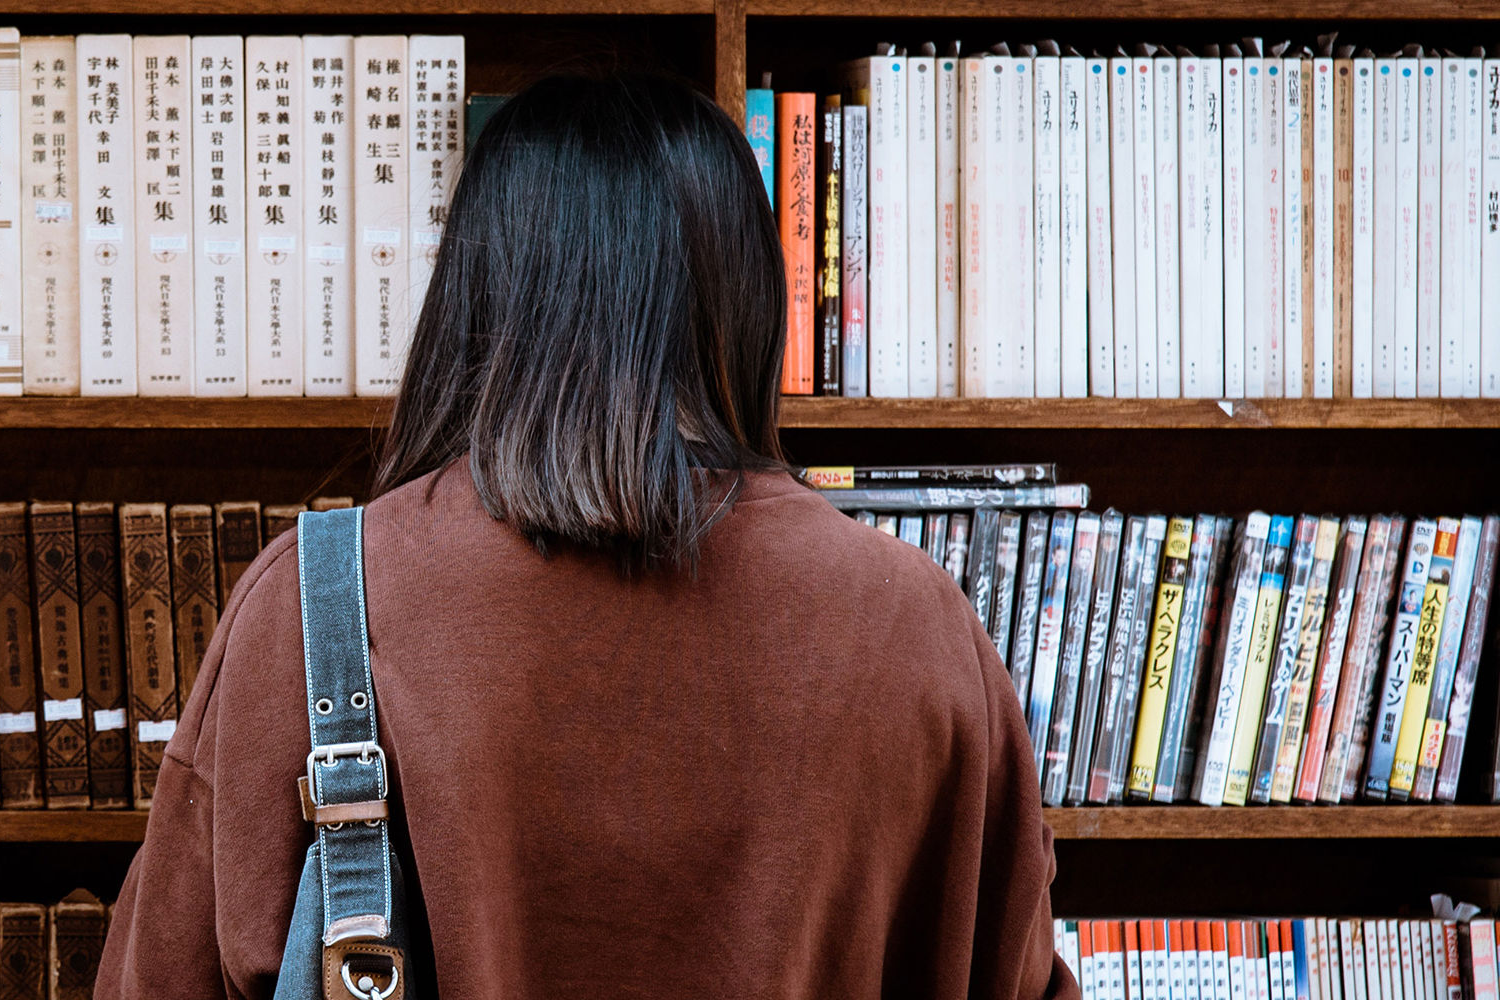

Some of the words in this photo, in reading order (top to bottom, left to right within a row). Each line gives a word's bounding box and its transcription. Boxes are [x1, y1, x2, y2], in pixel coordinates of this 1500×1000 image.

[88, 57, 102, 124] 宇野千代
[105, 57, 119, 124] 林芙美子
[276, 61, 290, 124] 村山知義
[367, 59, 381, 158] 梅崎春生
[387, 59, 401, 158] 椎名麟三
[97, 131, 112, 198] 幸田文
[257, 134, 272, 197] 三好十郎
[375, 164, 394, 184] 集
[96, 206, 115, 226] 集
[154, 201, 174, 221] 集
[209, 204, 228, 225] 集
[265, 205, 285, 225] 集
[319, 205, 338, 225] 集
[428, 205, 448, 226] 集
[1149, 589, 1179, 690] ザ・ヘラクレス
[1386, 620, 1414, 706] スーパーマン
[1412, 589, 1441, 686] 人生の特等席
